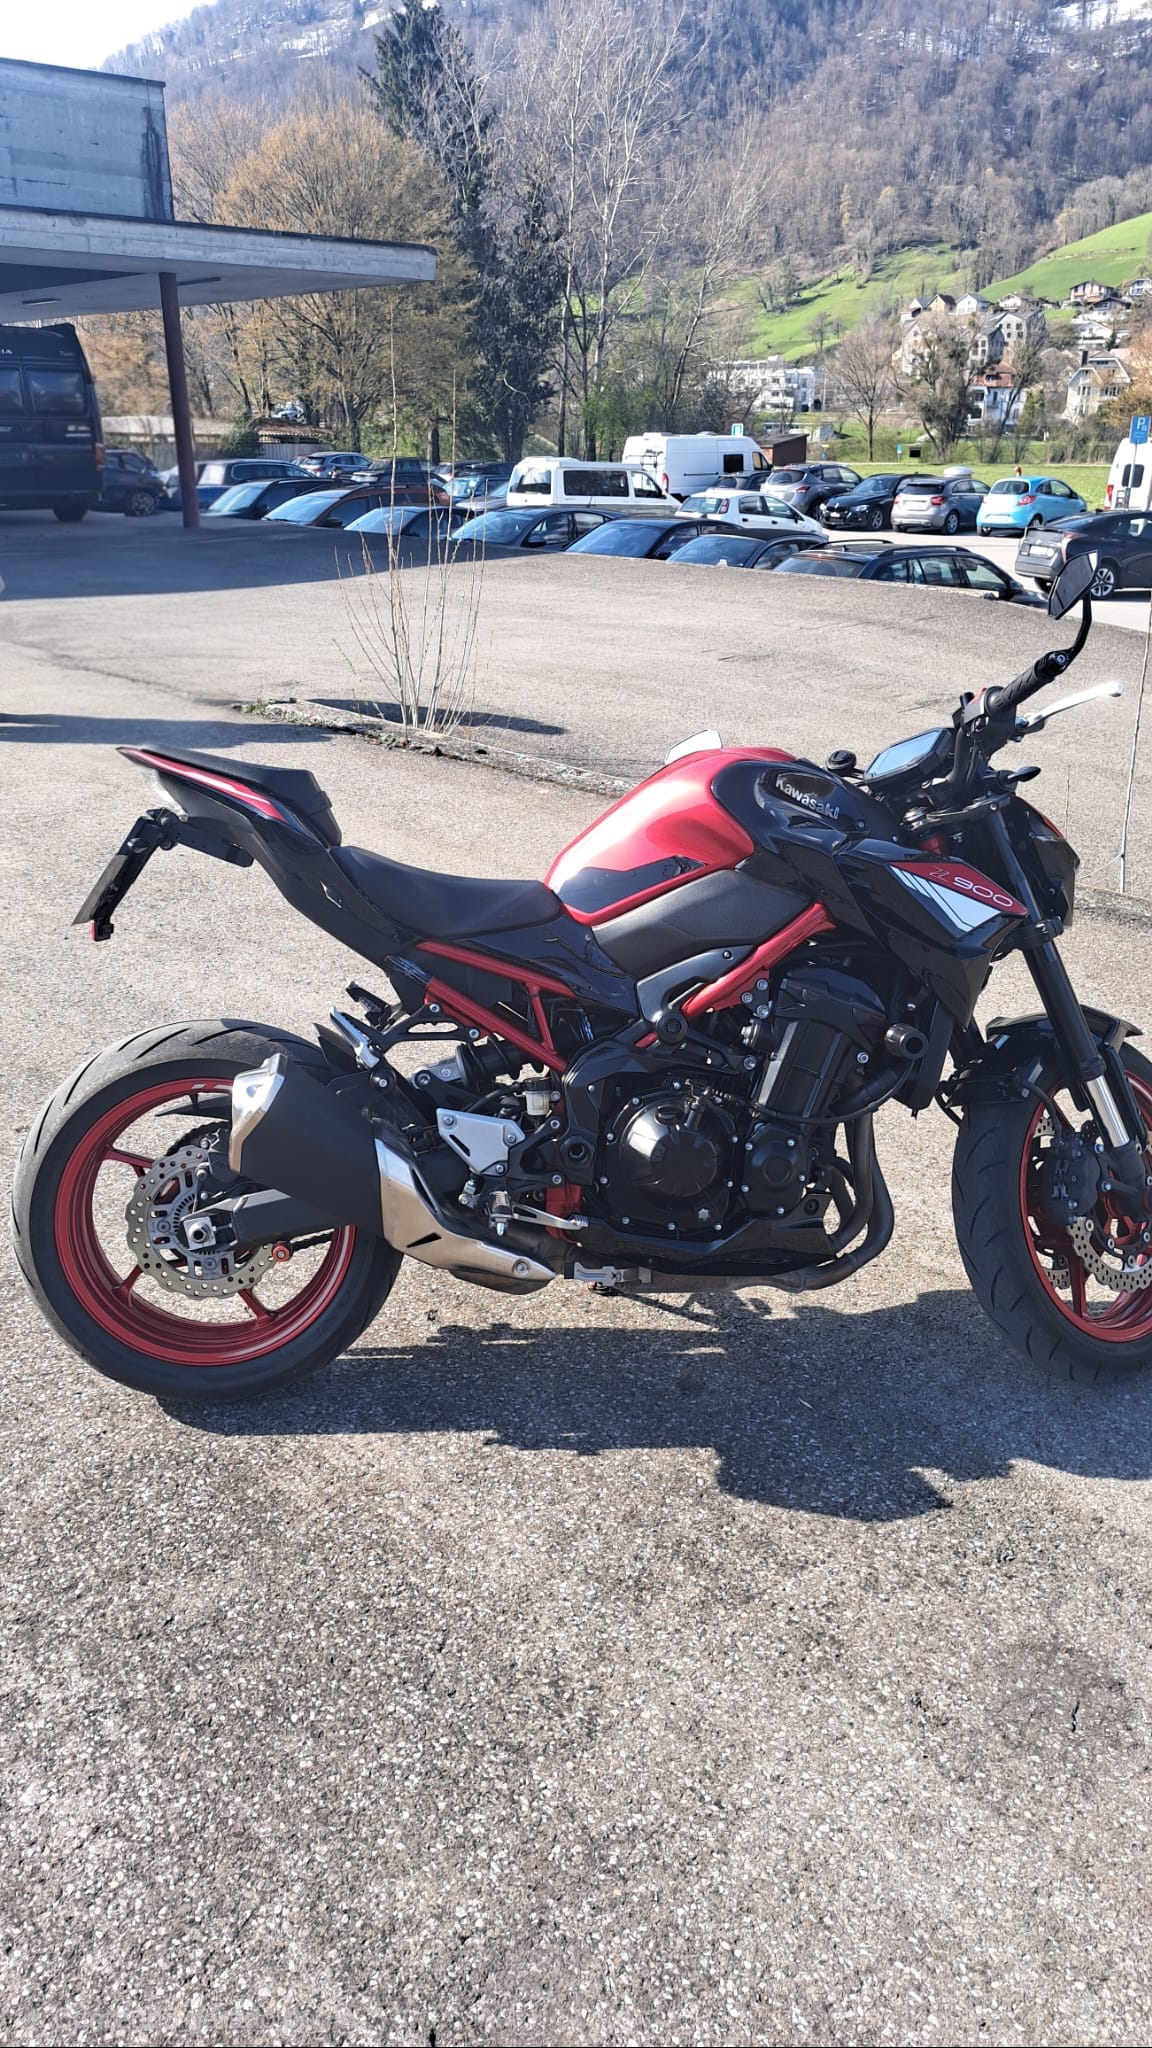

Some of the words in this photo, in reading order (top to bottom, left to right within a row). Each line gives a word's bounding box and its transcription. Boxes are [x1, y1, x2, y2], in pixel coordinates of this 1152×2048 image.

[1137, 417, 1146, 430] P
[775, 774, 840, 820] Kawasaki
[952, 876, 1014, 908] 900
